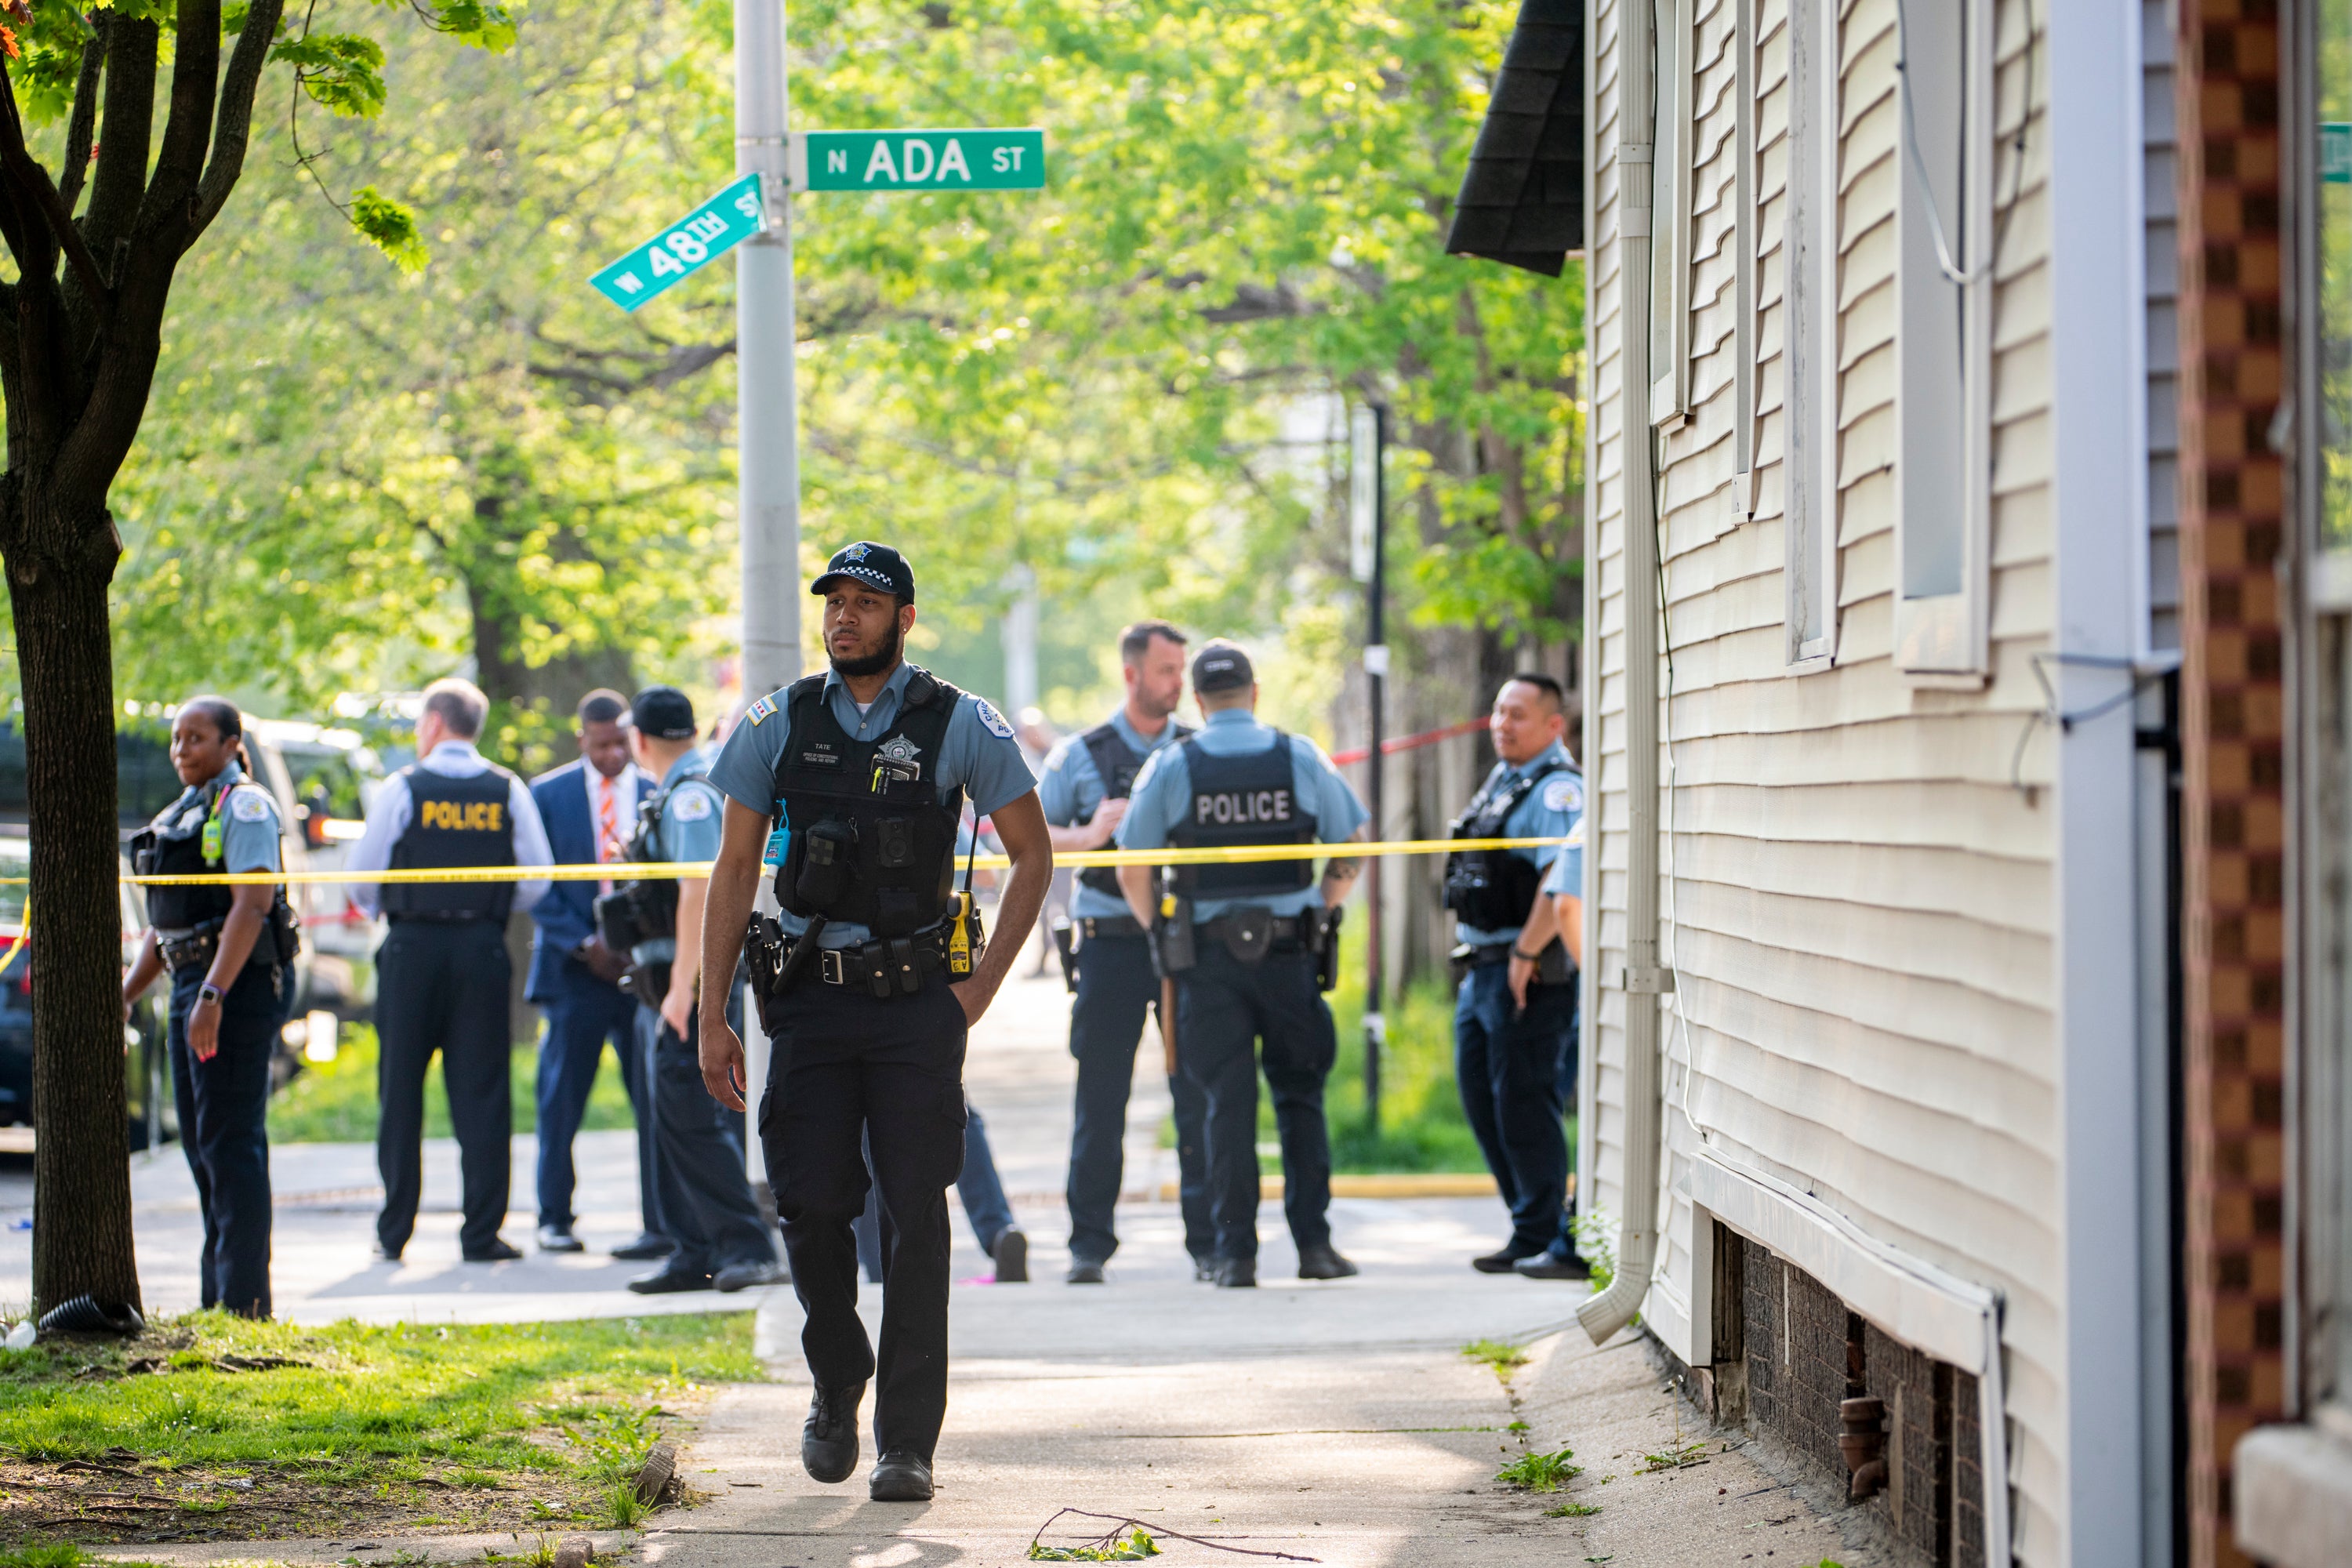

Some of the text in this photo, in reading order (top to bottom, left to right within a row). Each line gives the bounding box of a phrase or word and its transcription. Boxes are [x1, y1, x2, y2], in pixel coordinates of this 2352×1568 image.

[827, 138, 1025, 182] N ADA ST
[613, 270, 644, 295] W
[648, 210, 729, 278] 48TH
[886, 741, 913, 757] CHICAGO POLICE
[422, 800, 503, 831] POLICE
[1196, 790, 1290, 824] POLICE
